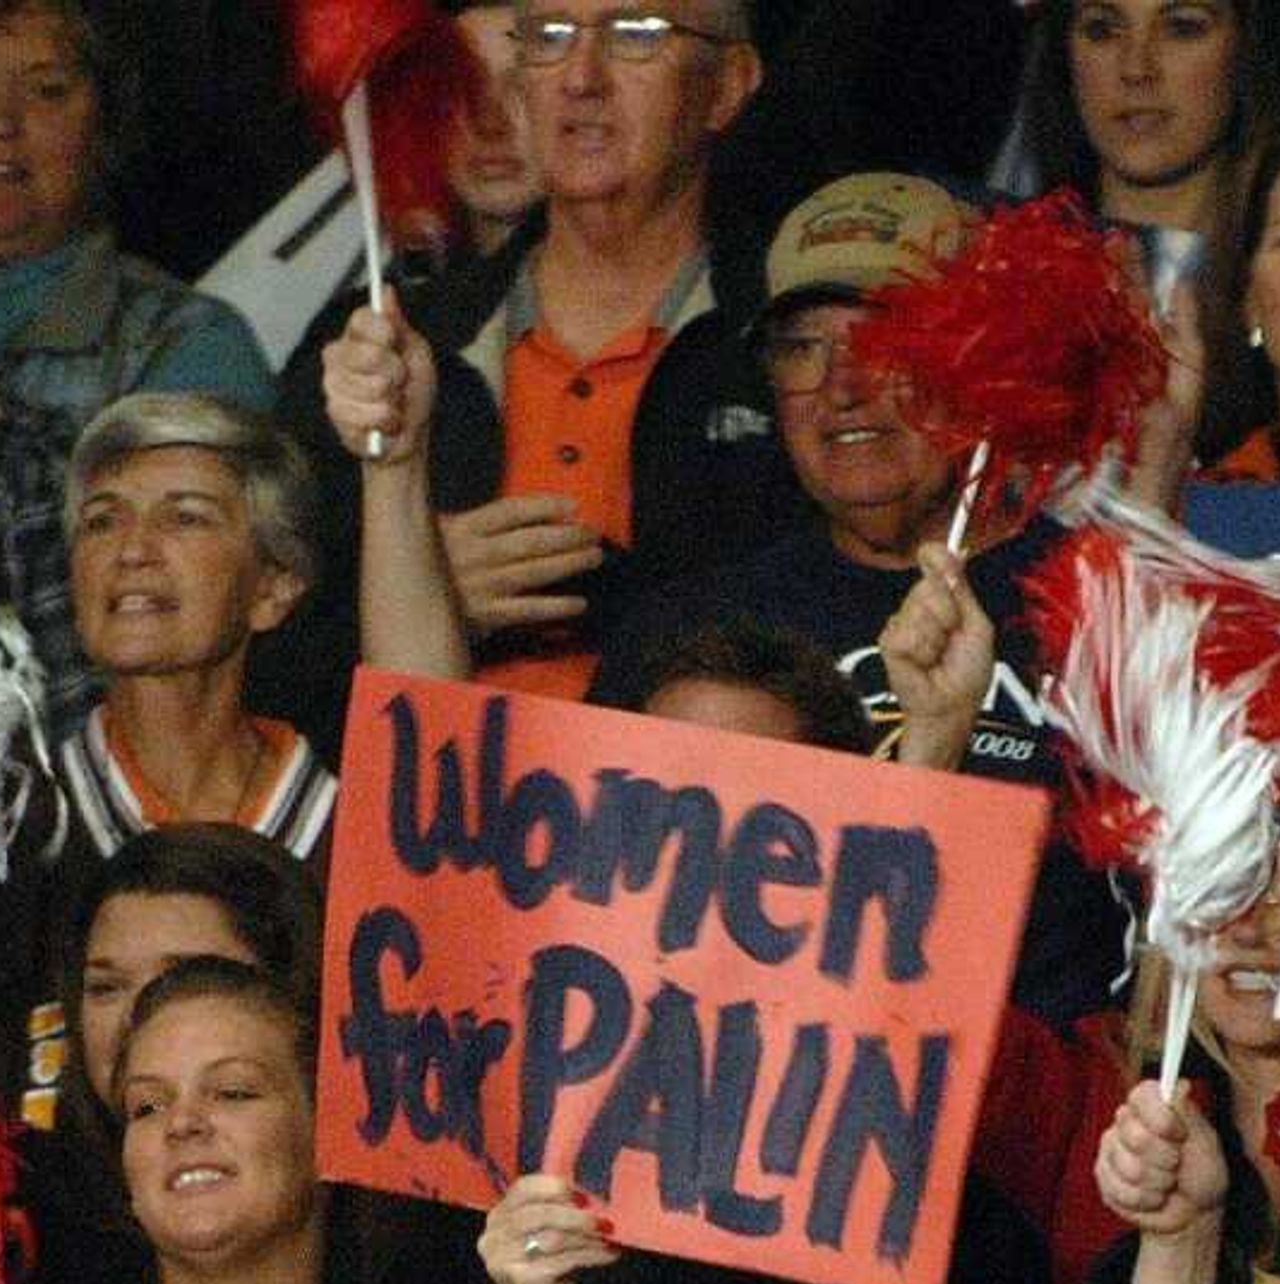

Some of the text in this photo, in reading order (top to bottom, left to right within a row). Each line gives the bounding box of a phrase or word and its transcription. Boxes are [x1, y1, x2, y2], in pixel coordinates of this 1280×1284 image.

[386, 693, 939, 990] Women
[967, 731, 1036, 761] 008
[340, 905, 510, 1190] for
[519, 943, 951, 1272] PALIN
